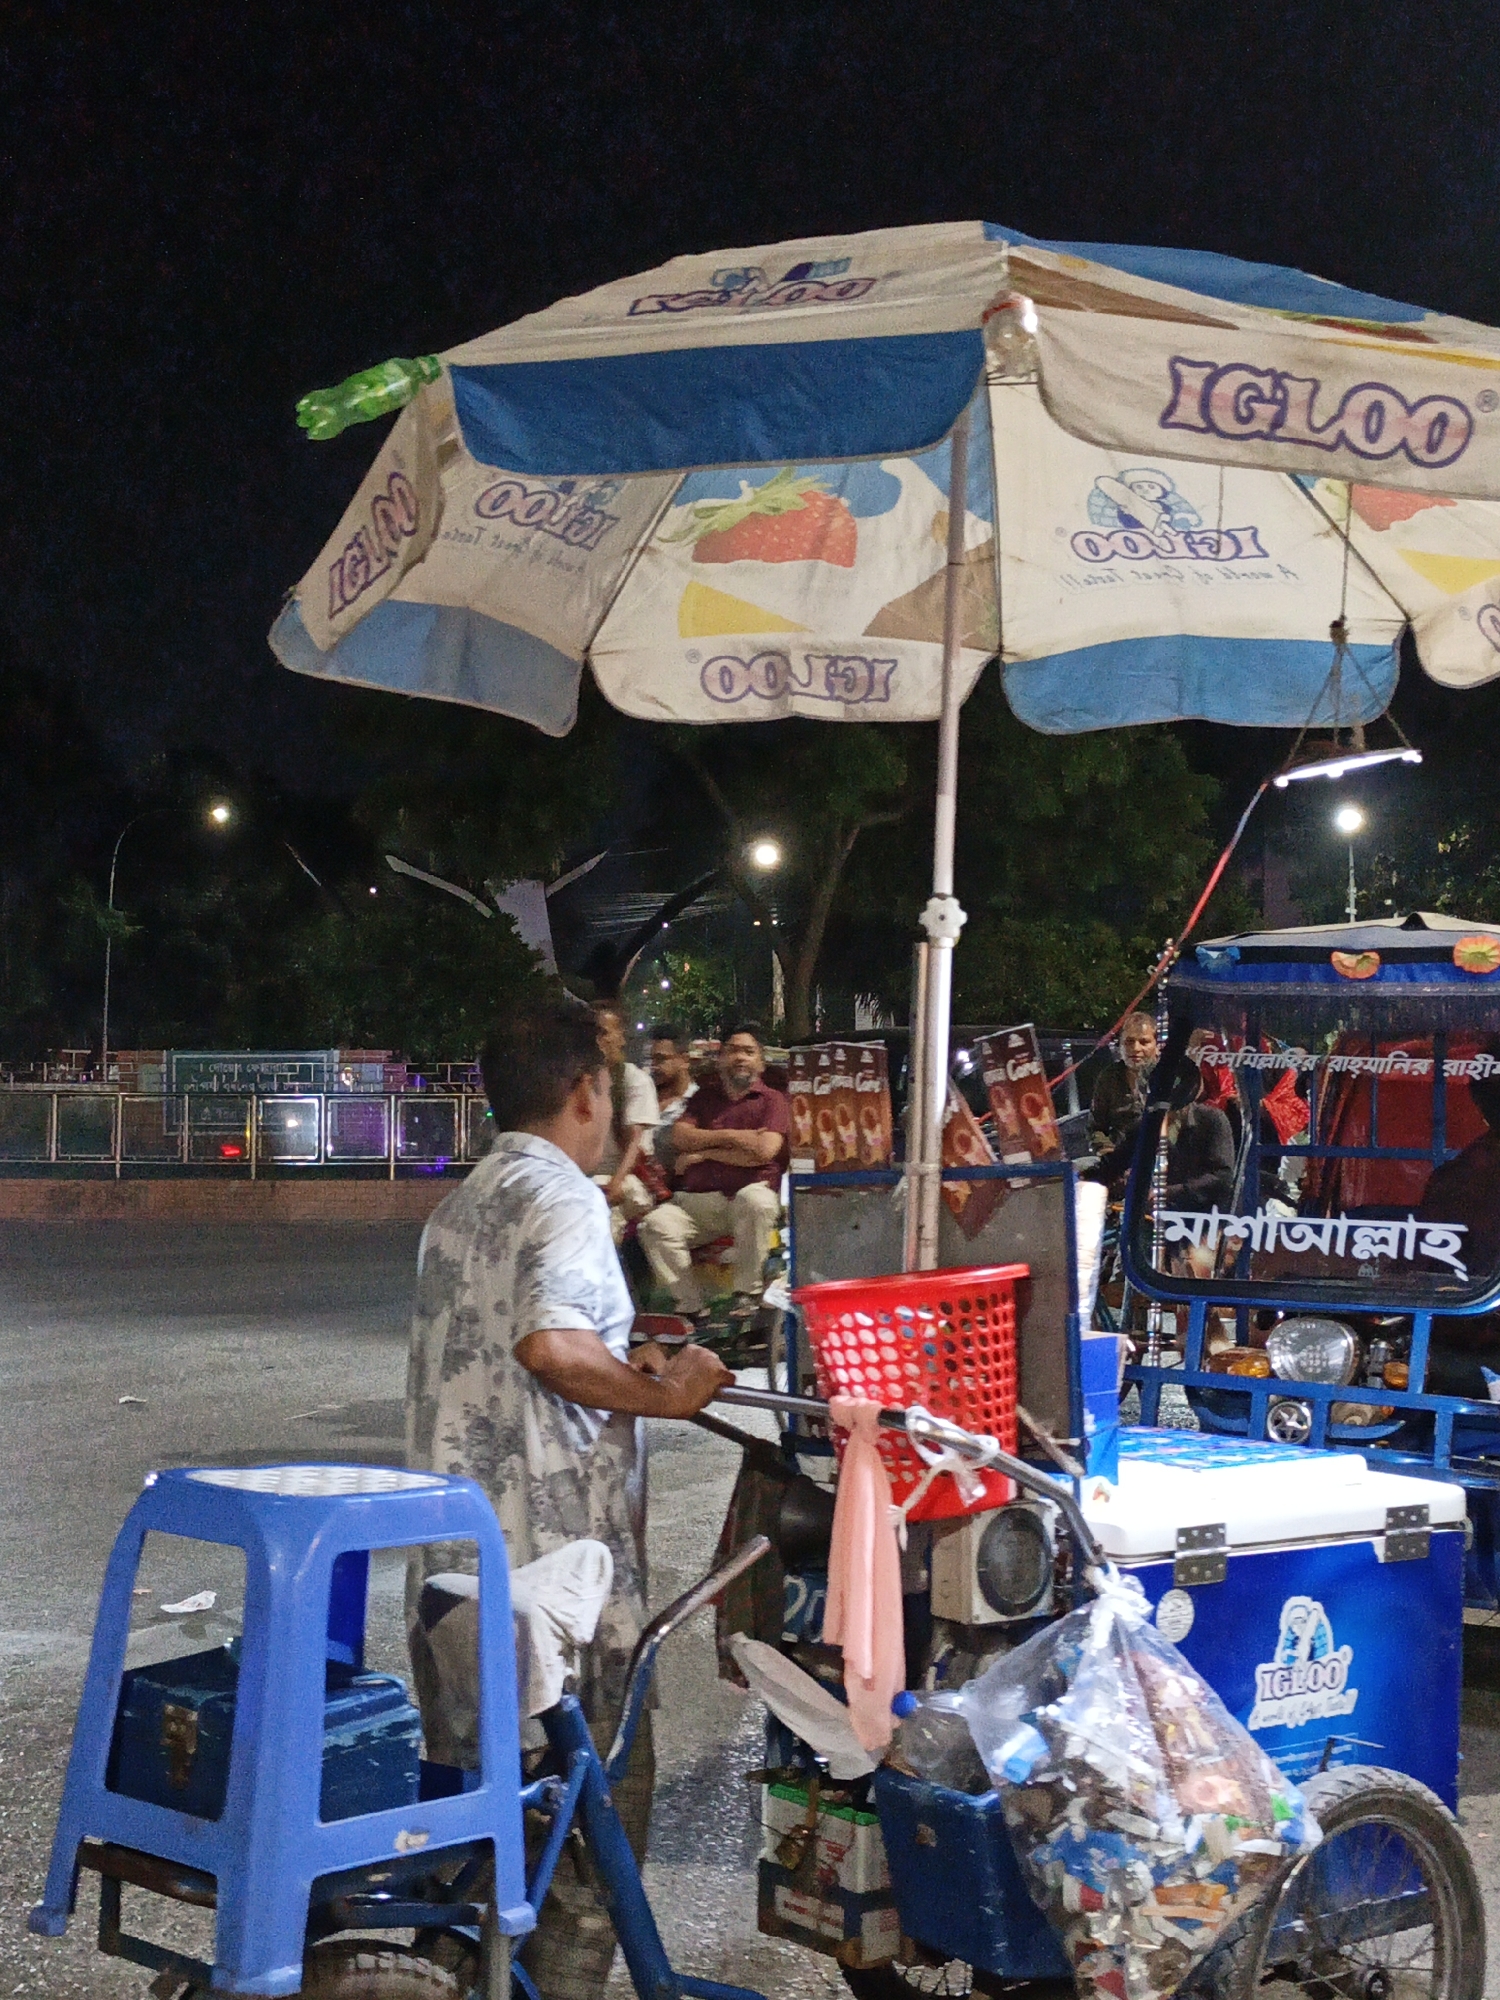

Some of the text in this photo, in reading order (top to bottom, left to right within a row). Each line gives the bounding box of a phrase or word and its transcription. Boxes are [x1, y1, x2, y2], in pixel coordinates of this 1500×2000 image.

[1159, 355, 1476, 470] IGLOO
[328, 471, 419, 619] IGLOO
[1259, 1658, 1343, 1702] IGLOO
